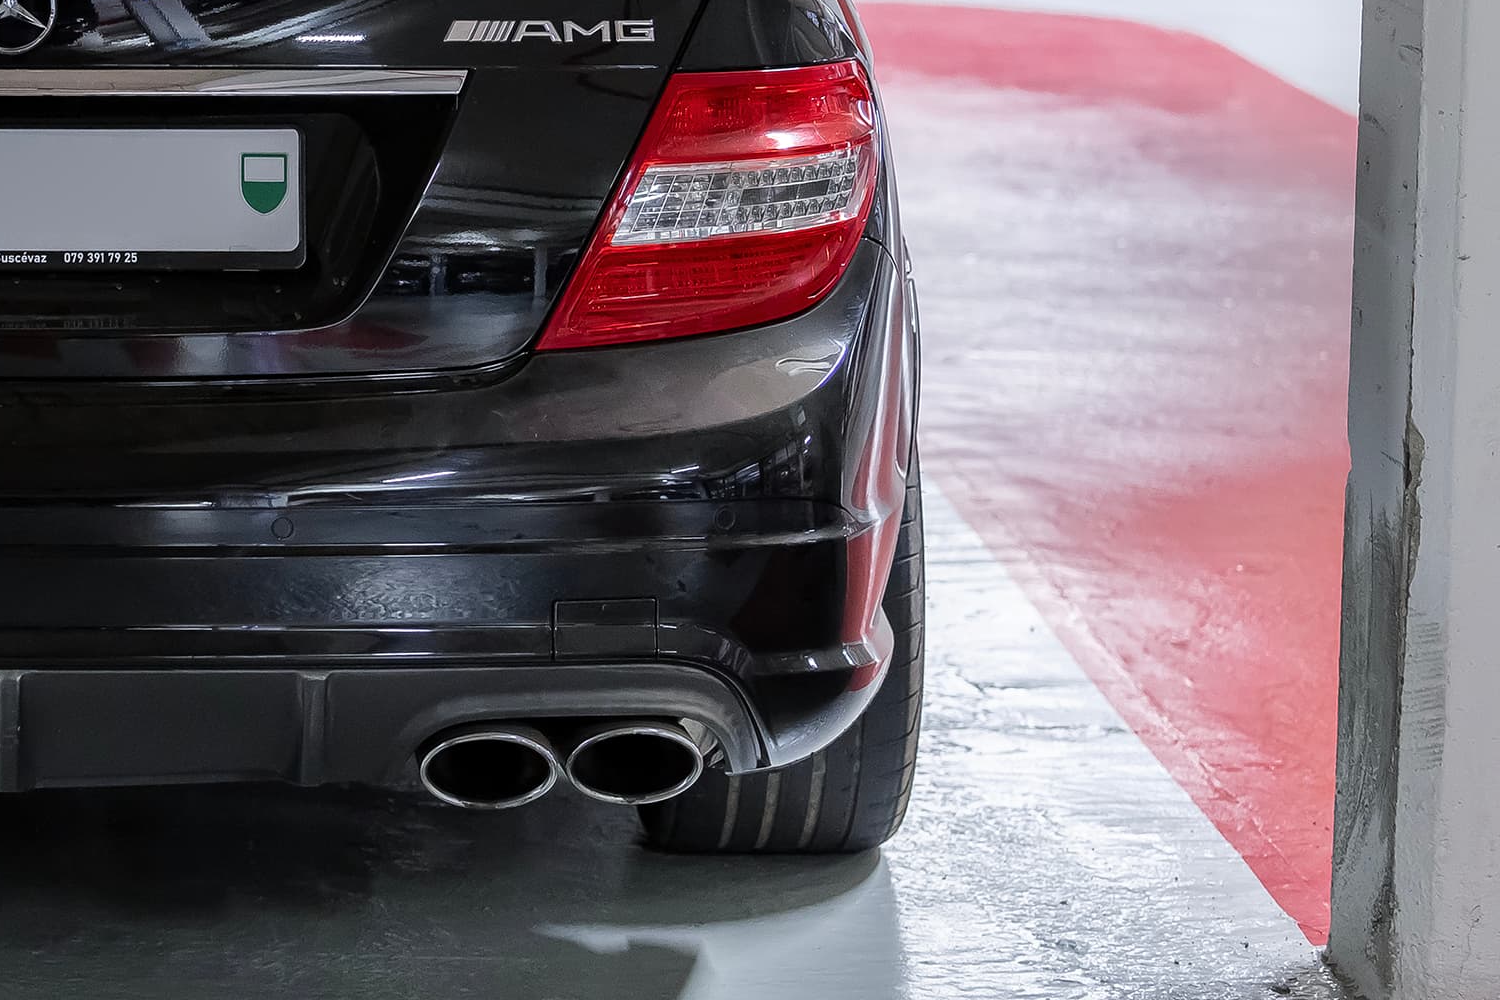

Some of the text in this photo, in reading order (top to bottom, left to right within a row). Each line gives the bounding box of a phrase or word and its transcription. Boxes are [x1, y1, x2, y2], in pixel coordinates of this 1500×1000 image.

[511, 20, 655, 43] AMG
[64, 252, 84, 263] 079
[87, 252, 105, 263] 391
[107, 252, 121, 263] 79
[124, 252, 138, 263] 25
